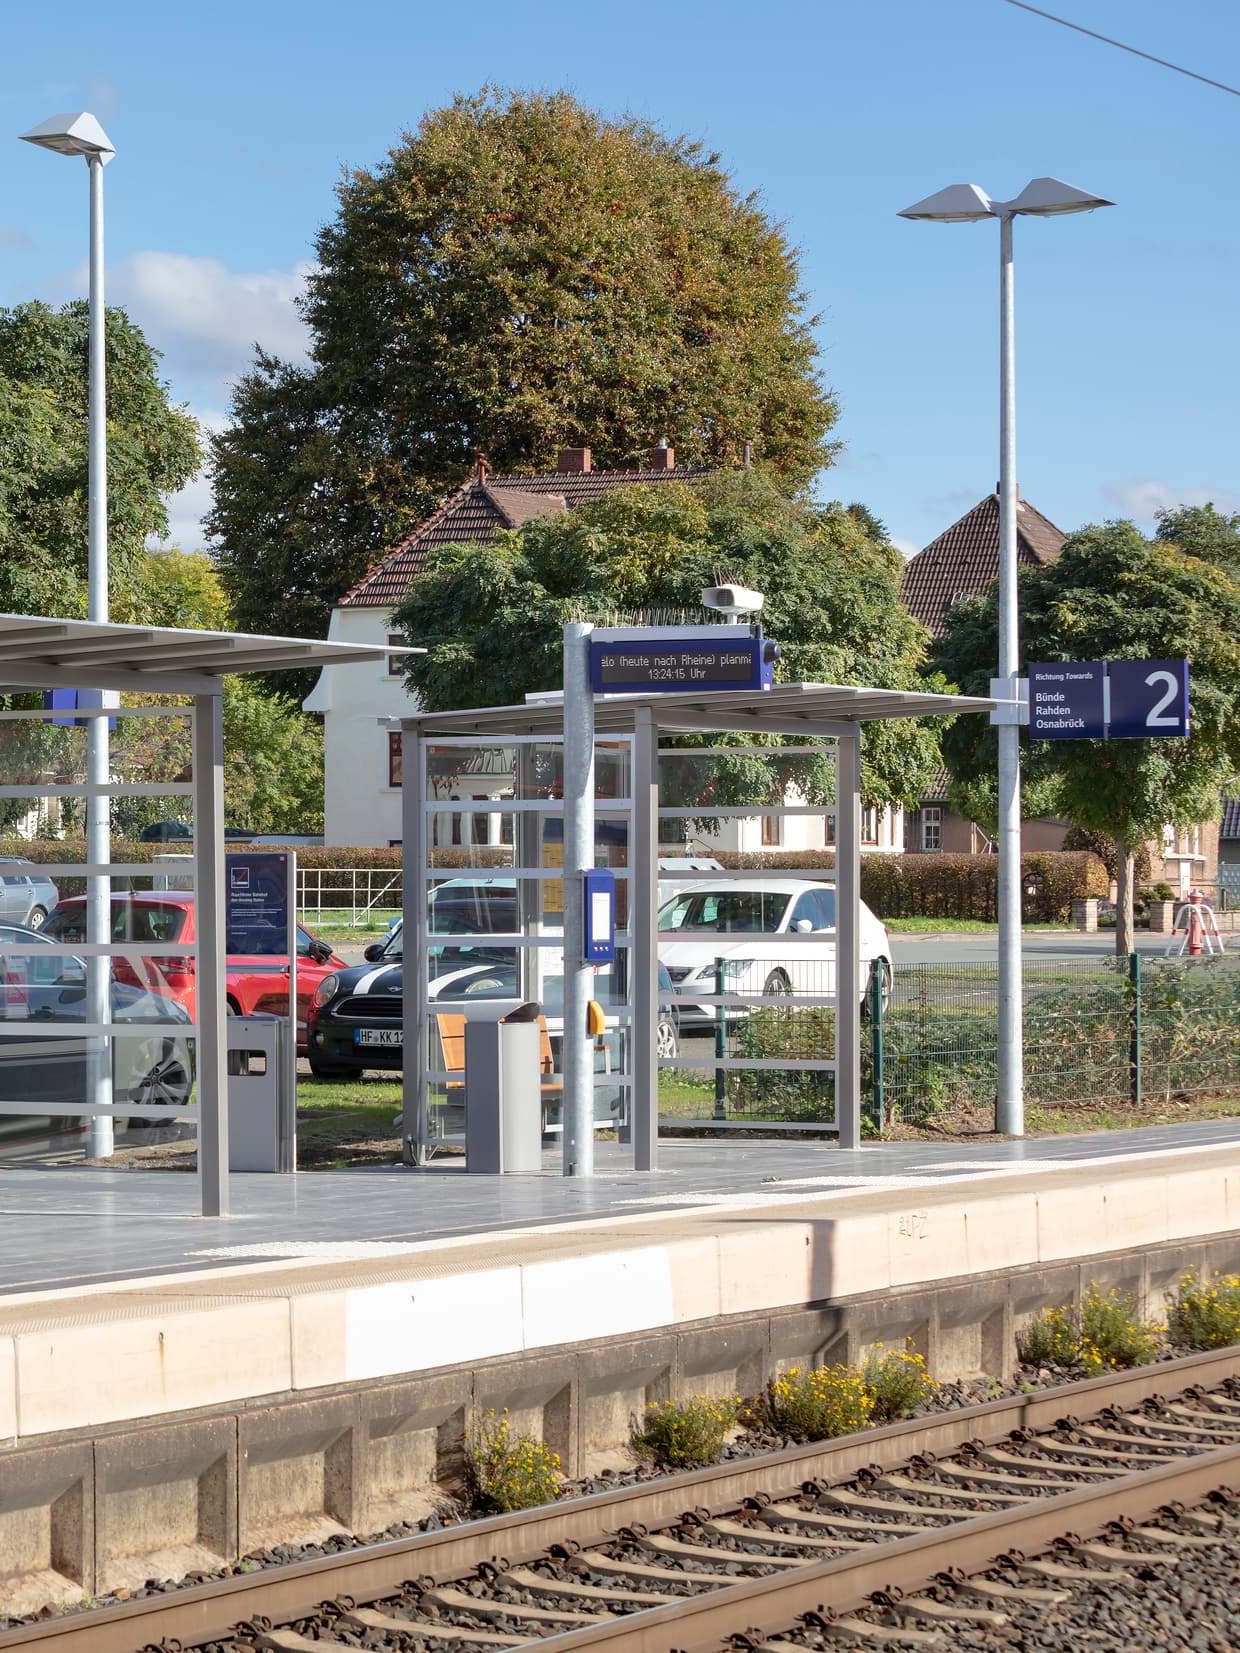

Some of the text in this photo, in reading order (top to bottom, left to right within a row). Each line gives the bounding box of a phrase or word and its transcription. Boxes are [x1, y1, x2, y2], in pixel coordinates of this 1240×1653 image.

[619, 655, 649, 667] (heute
[654, 655, 677, 666] nach
[681, 654, 716, 666] Rheine)
[648, 668, 707, 680] 13:24:15 Uhr
[1035, 672, 1093, 682] Richtung Towards
[1035, 692, 1065, 702] Bünde
[1144, 670, 1180, 727] 2
[1035, 705, 1071, 715] Rahden
[1036, 718, 1085, 729] Osnabrück
[360, 1031, 373, 1042] HF
[379, 1031, 392, 1043] KK
